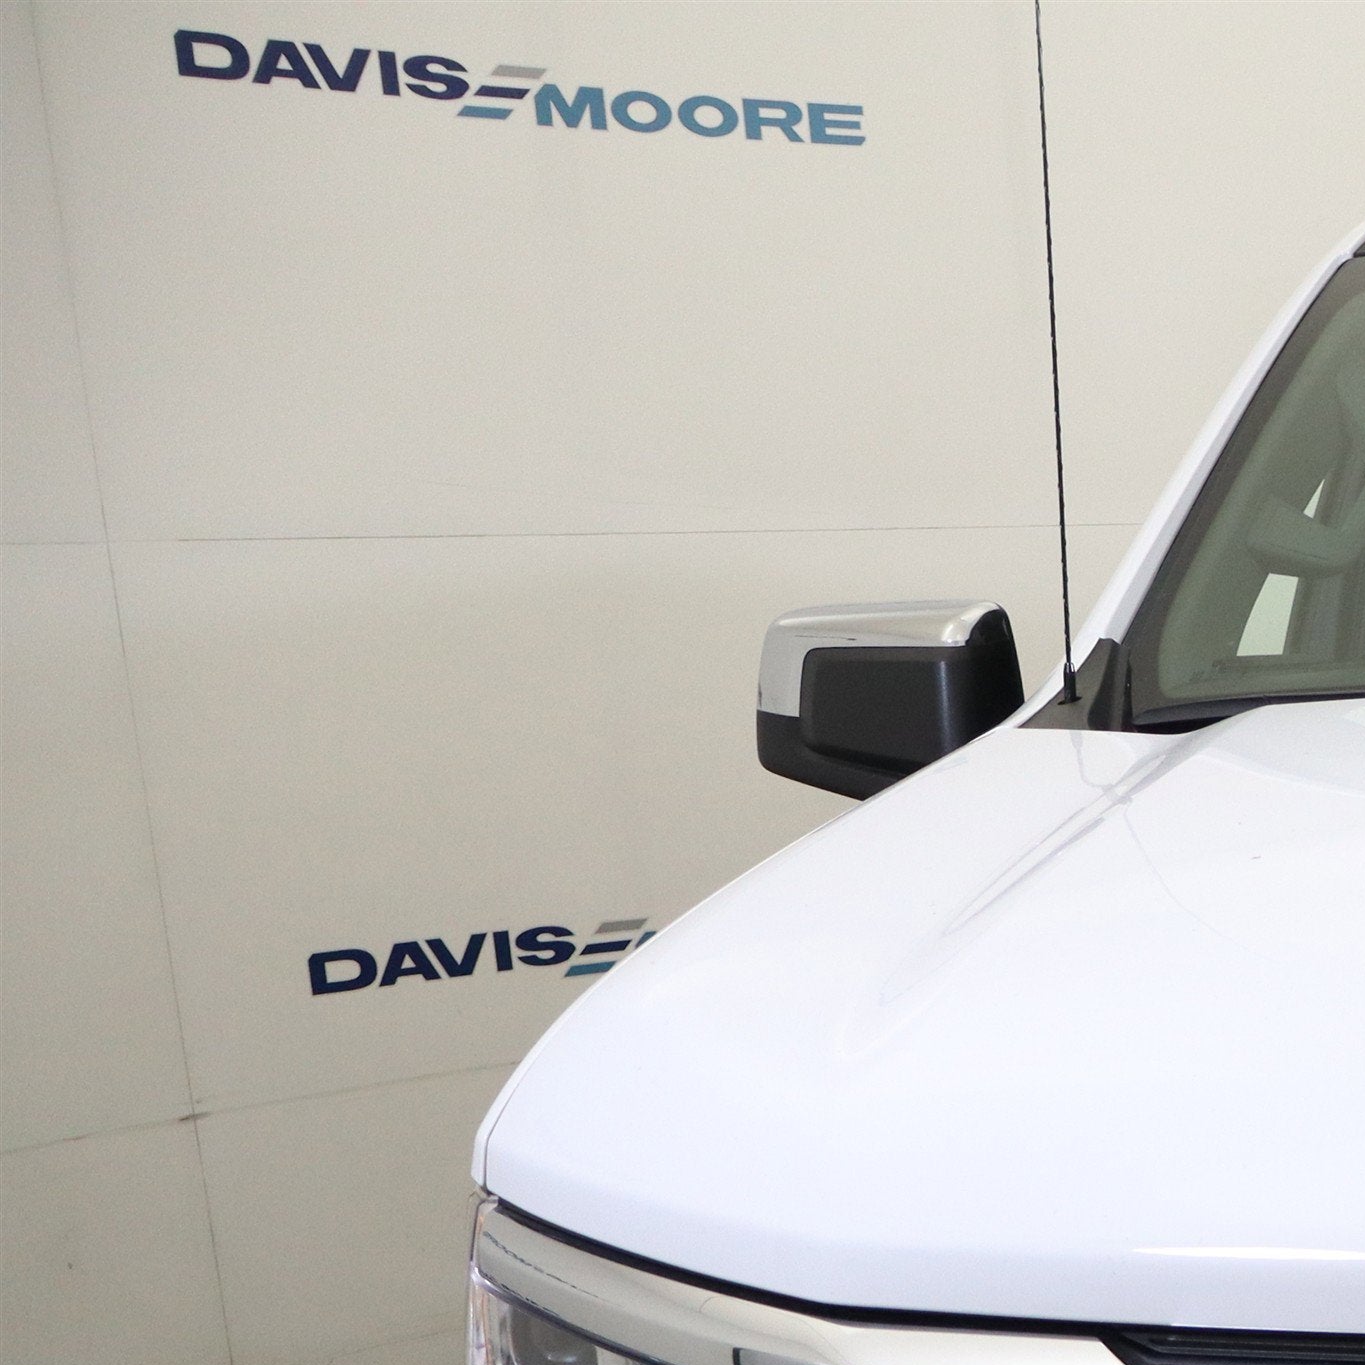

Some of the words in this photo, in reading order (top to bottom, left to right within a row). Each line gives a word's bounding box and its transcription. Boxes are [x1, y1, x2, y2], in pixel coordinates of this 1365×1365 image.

[174, 28, 469, 99] DAVIS
[534, 83, 866, 146] MOORE
[308, 926, 576, 996] DAVIS
